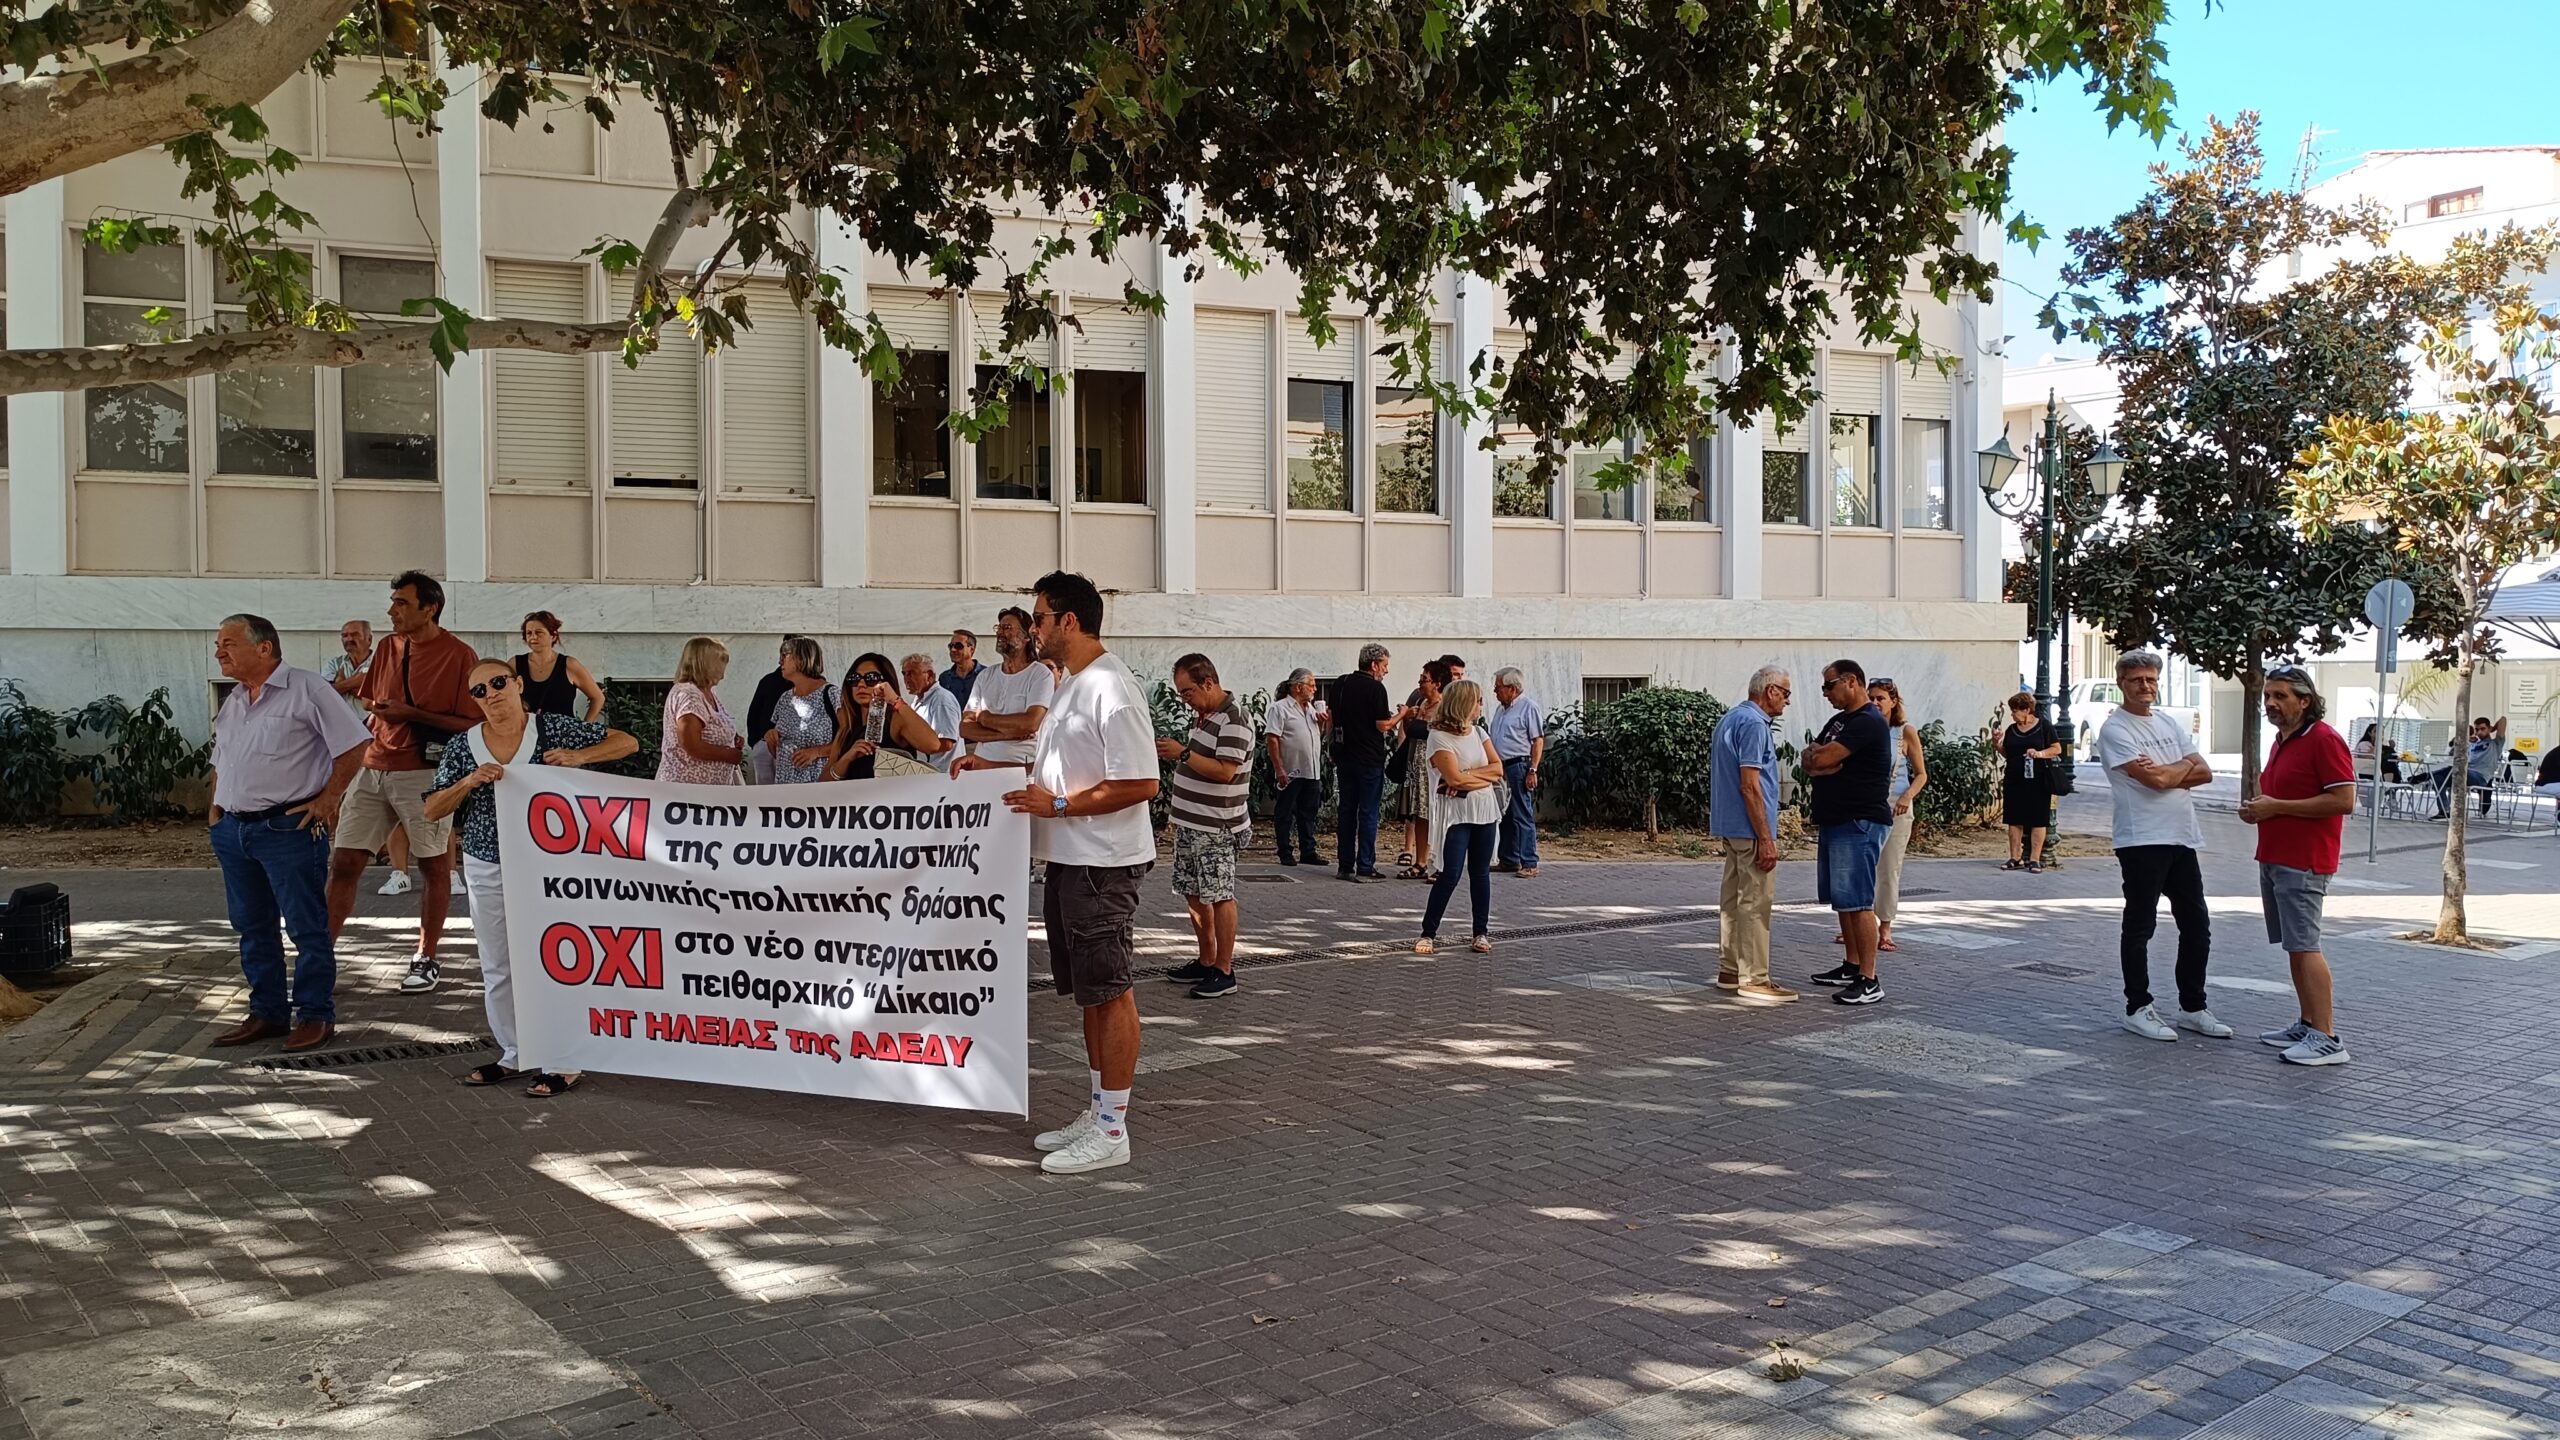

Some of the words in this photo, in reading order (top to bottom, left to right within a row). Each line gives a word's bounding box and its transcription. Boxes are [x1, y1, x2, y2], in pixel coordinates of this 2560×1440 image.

[528, 792, 650, 860] ΟΧΙ
[664, 801, 748, 826] στην
[758, 796, 991, 830] ποινικοποίηση
[666, 840, 722, 870] της
[733, 836, 980, 875] συνδικαλιστικής
[543, 877, 892, 921] κοινωνικής-πολιτικής
[901, 886, 1006, 925] δράσης
[540, 922, 664, 989] ΟΧΙ
[675, 931, 734, 956] στο
[744, 930, 804, 960] νέο
[815, 939, 998, 978] αντεργατικό
[682, 969, 854, 1010] πειθαρχικό
[589, 1007, 638, 1038] ΝΤ
[645, 1011, 778, 1050] ΗΛΕΙΑΣ
[785, 1028, 842, 1063] της
[850, 1031, 973, 1068] ΑΔΕΔΥ
